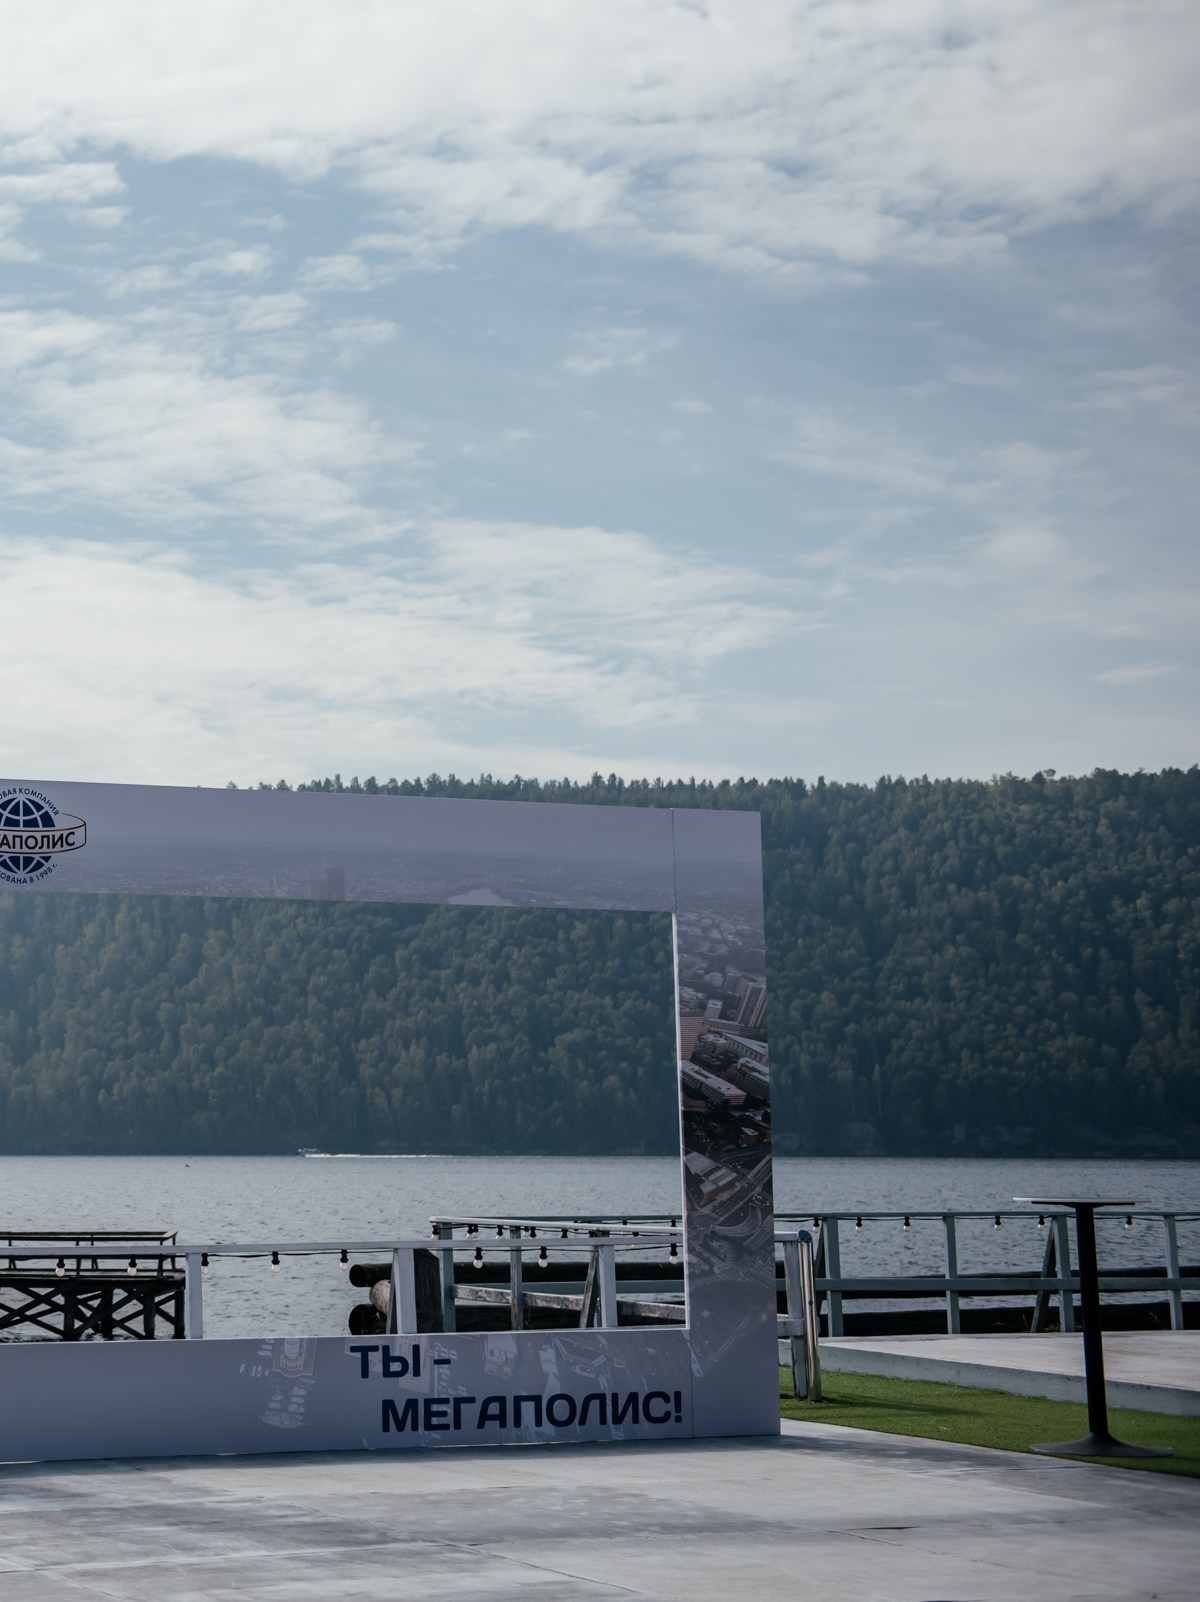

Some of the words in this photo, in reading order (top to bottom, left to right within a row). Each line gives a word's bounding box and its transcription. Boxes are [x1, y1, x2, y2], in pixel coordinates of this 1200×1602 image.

[18, 787, 60, 816] КОМПАНИЯ
[29, 876, 35, 884] В
[35, 867, 53, 881] 1998
[350, 1344, 421, 1378] ТЫ
[381, 1391, 683, 1433] МЕГАПОЛИС!
